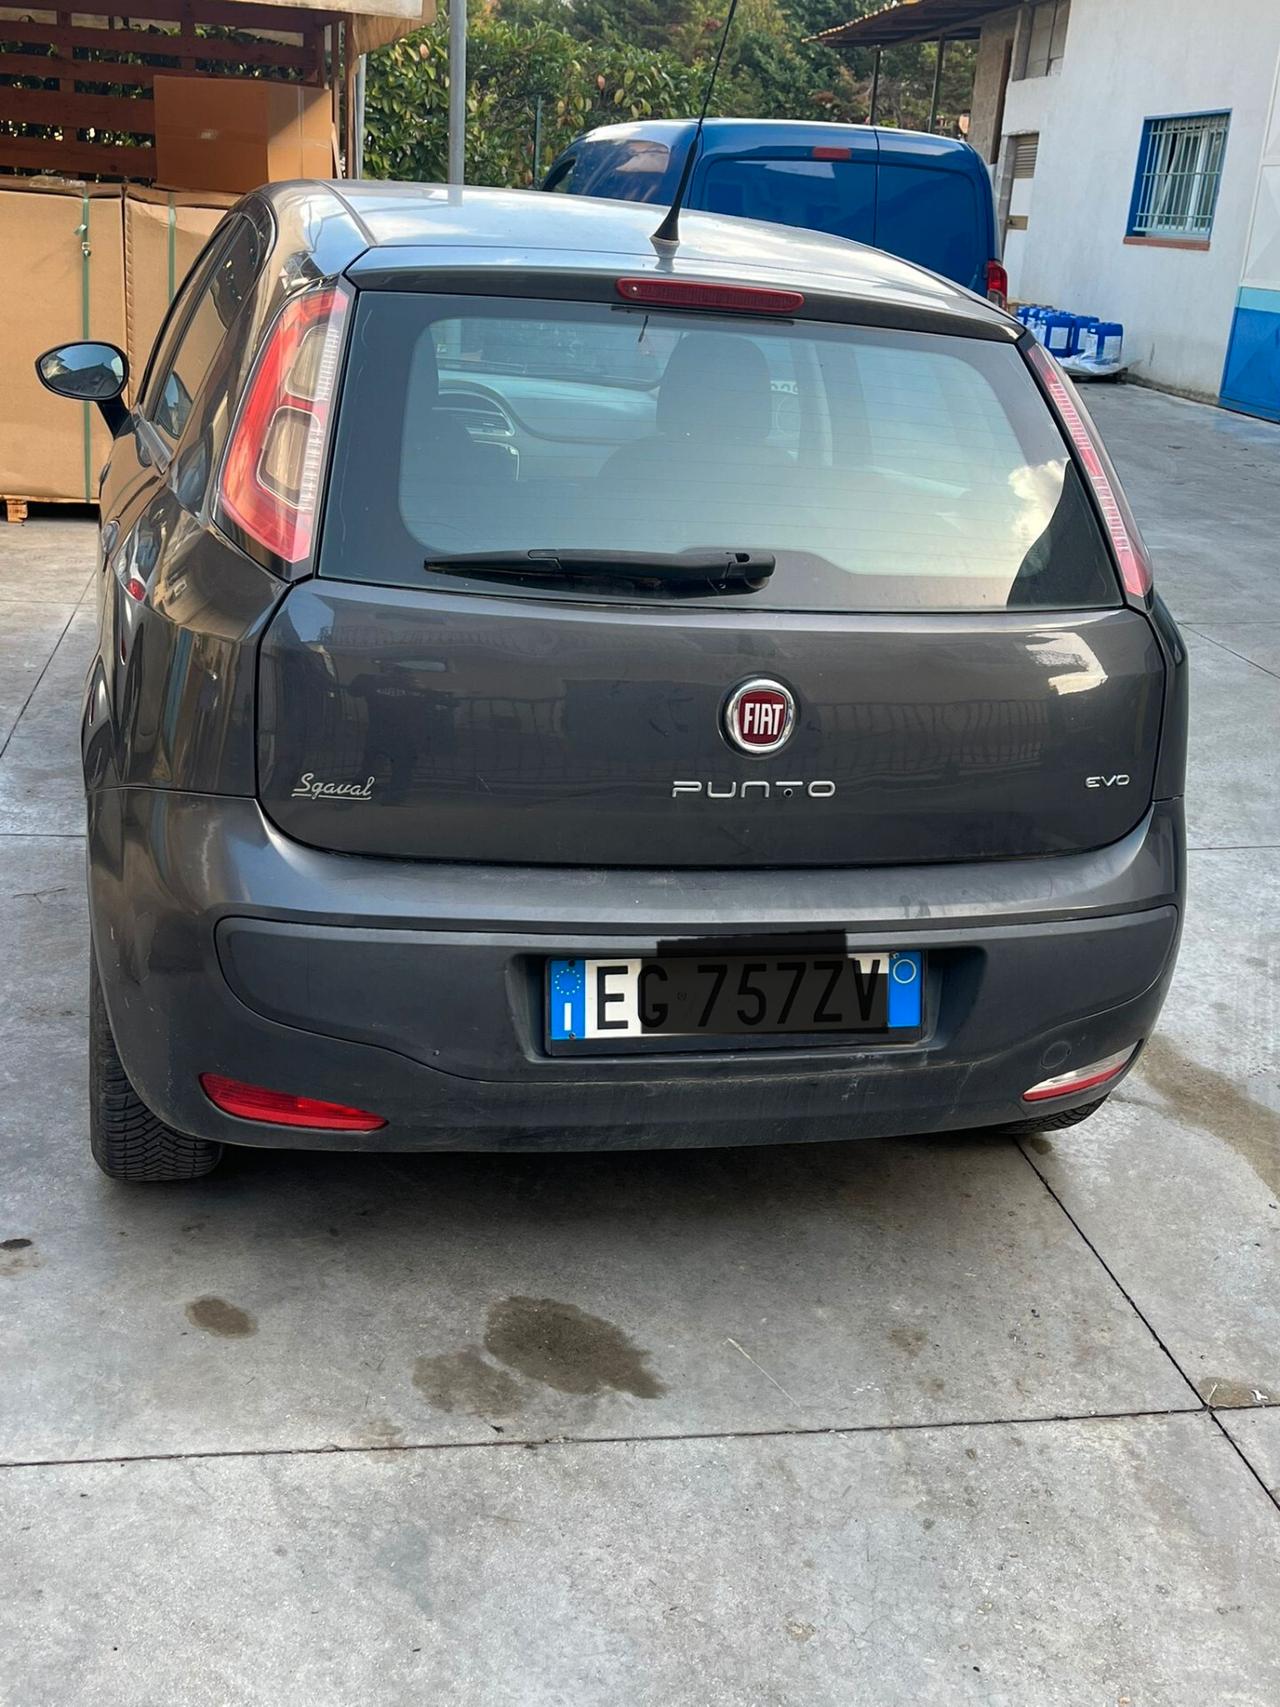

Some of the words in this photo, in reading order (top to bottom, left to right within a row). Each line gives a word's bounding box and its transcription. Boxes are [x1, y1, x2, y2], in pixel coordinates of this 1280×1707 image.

[743, 703, 784, 735] FIAT
[292, 772, 375, 800] Sgaval
[671, 780, 836, 798] PUNTO
[1086, 774, 1130, 788] EVO
